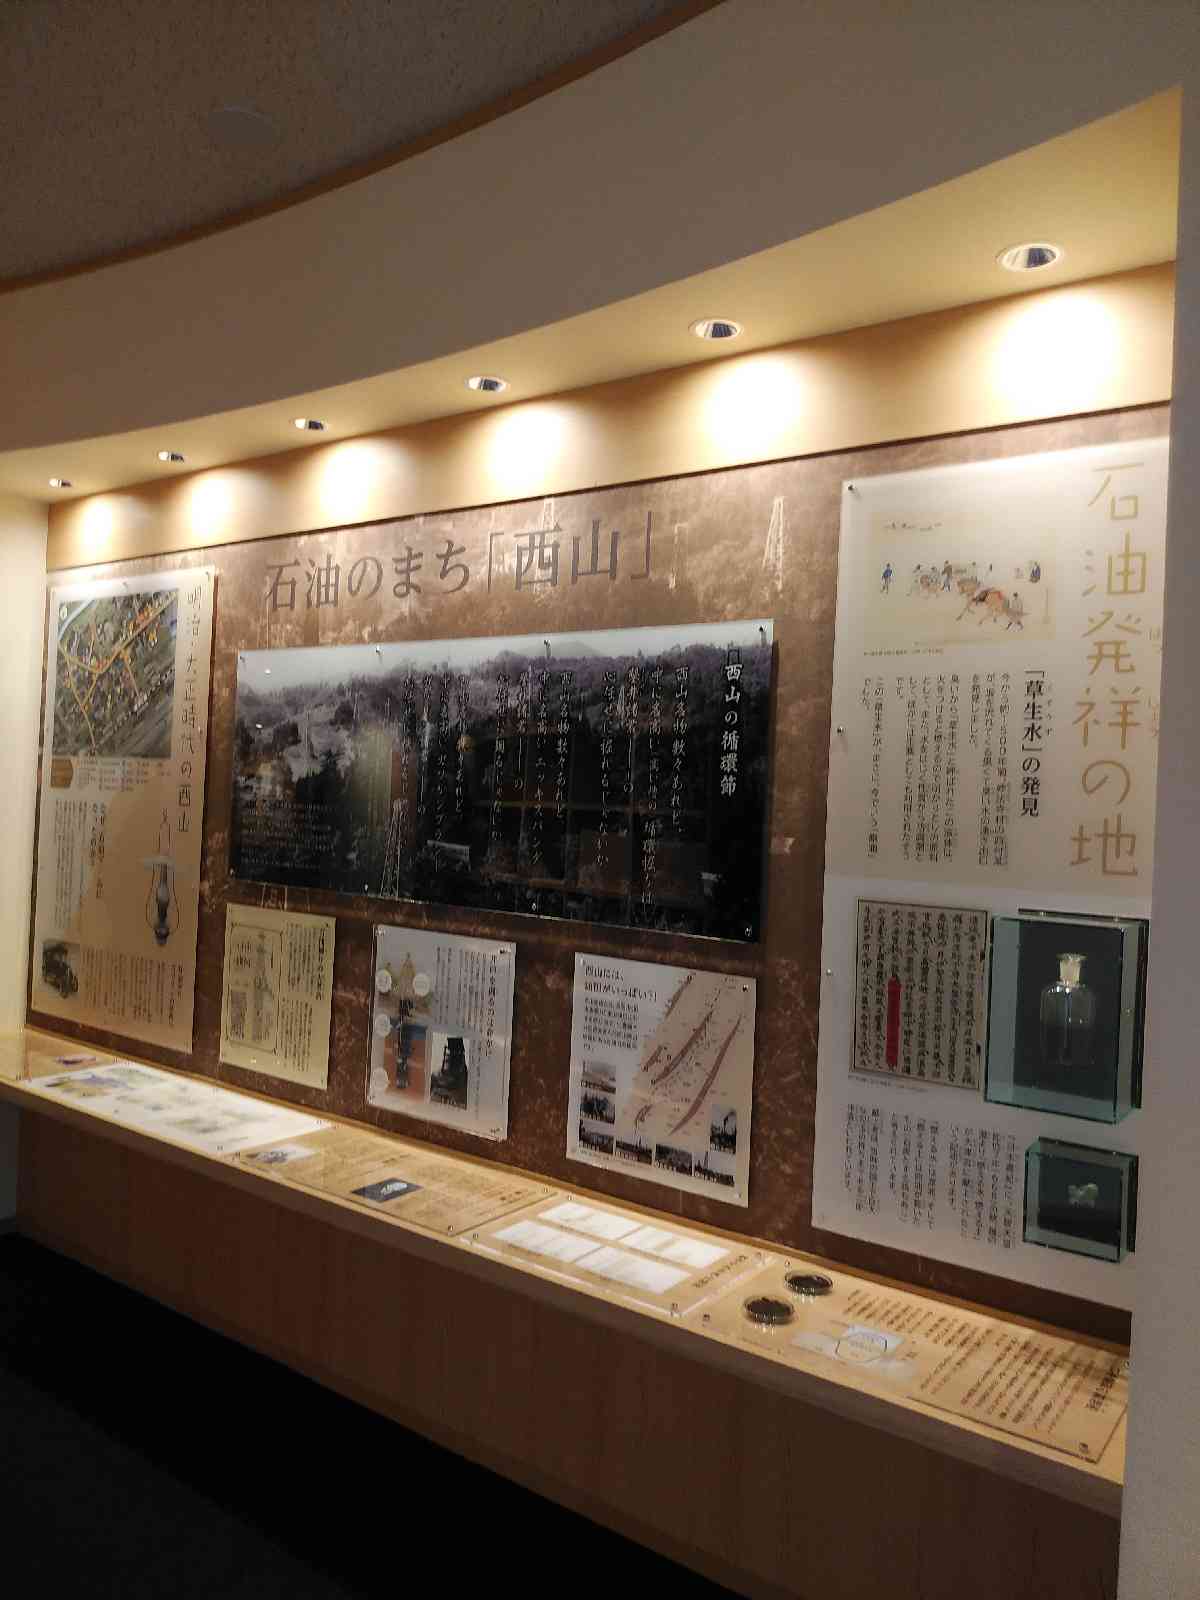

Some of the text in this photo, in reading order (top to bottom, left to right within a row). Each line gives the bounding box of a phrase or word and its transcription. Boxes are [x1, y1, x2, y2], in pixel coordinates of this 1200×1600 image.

[264, 510, 653, 612] 石油のまち「西山」
[720, 663, 744, 798] 西山の循環節
[1069, 462, 1148, 879] 石油発祥の地
[1021, 669, 1045, 818] 「草生水」の発見
